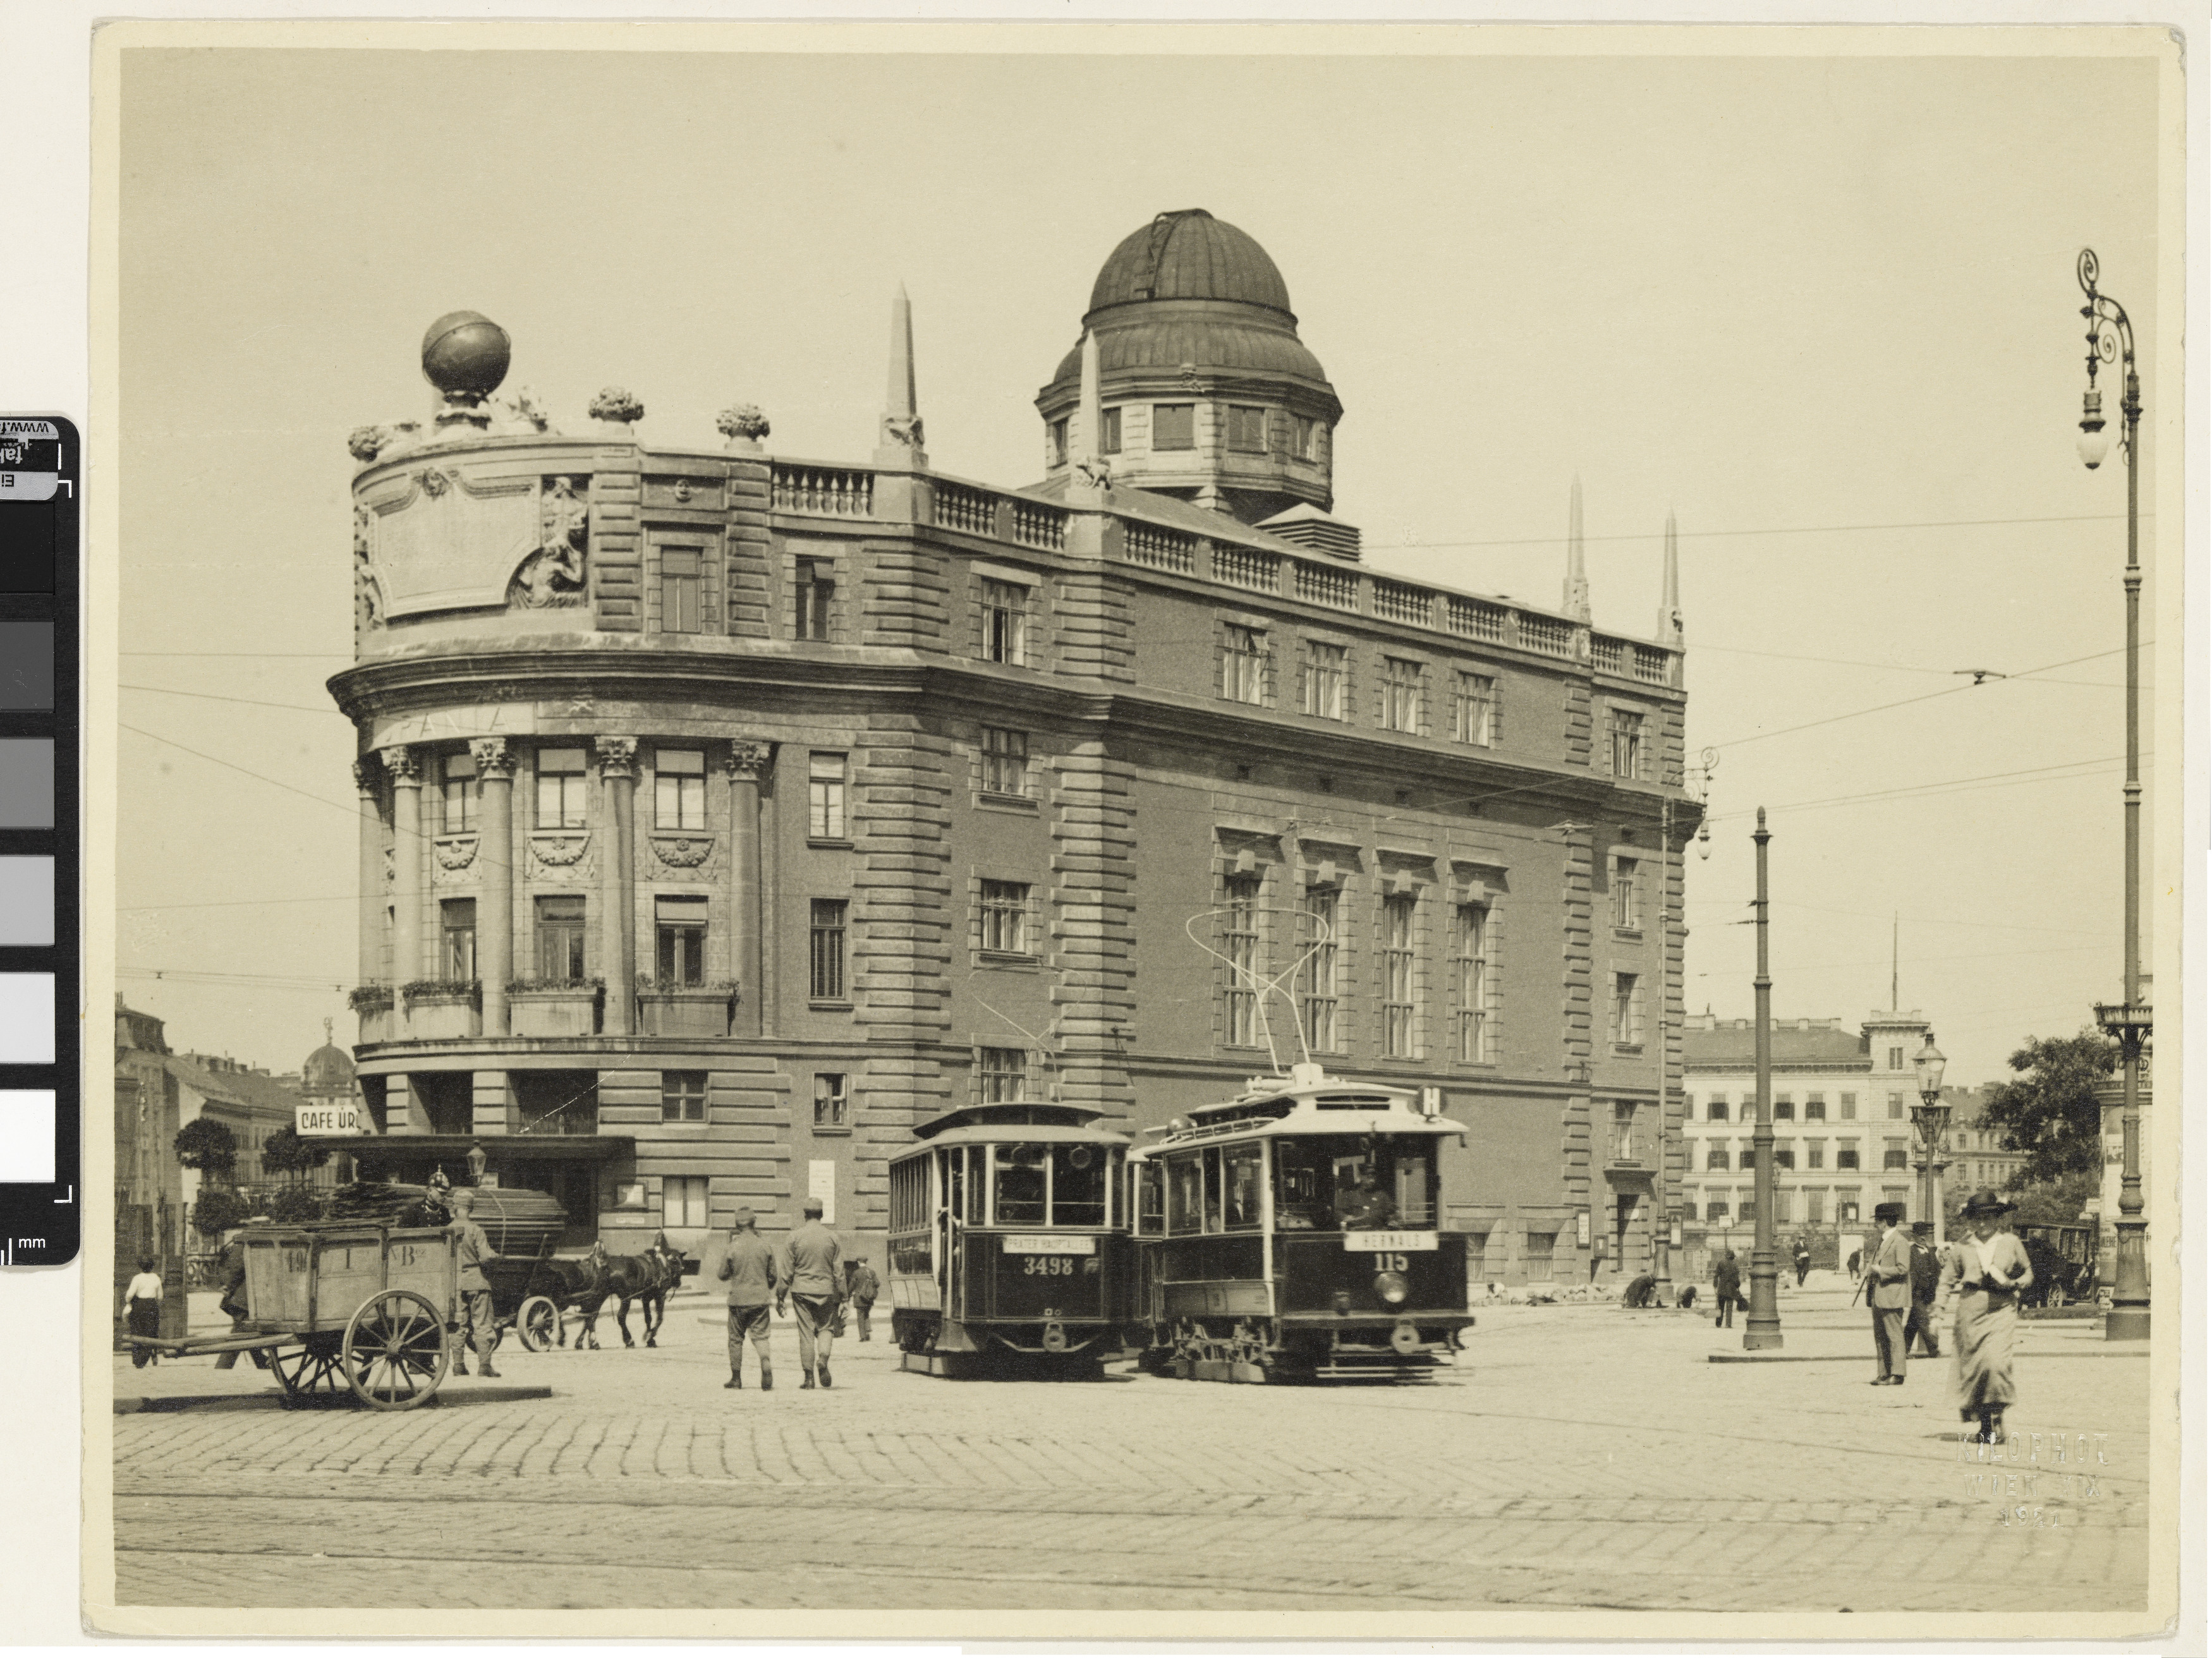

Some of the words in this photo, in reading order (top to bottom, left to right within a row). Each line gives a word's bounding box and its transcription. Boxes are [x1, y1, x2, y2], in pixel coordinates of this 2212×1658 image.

[0, 422, 49, 433] www.f
[1423, 1087, 1440, 1115] H
[301, 1112, 333, 1129] CAFE
[18, 1238, 46, 1249] mm
[1023, 1256, 1074, 1275] 3498
[1374, 1252, 1409, 1272] 115
